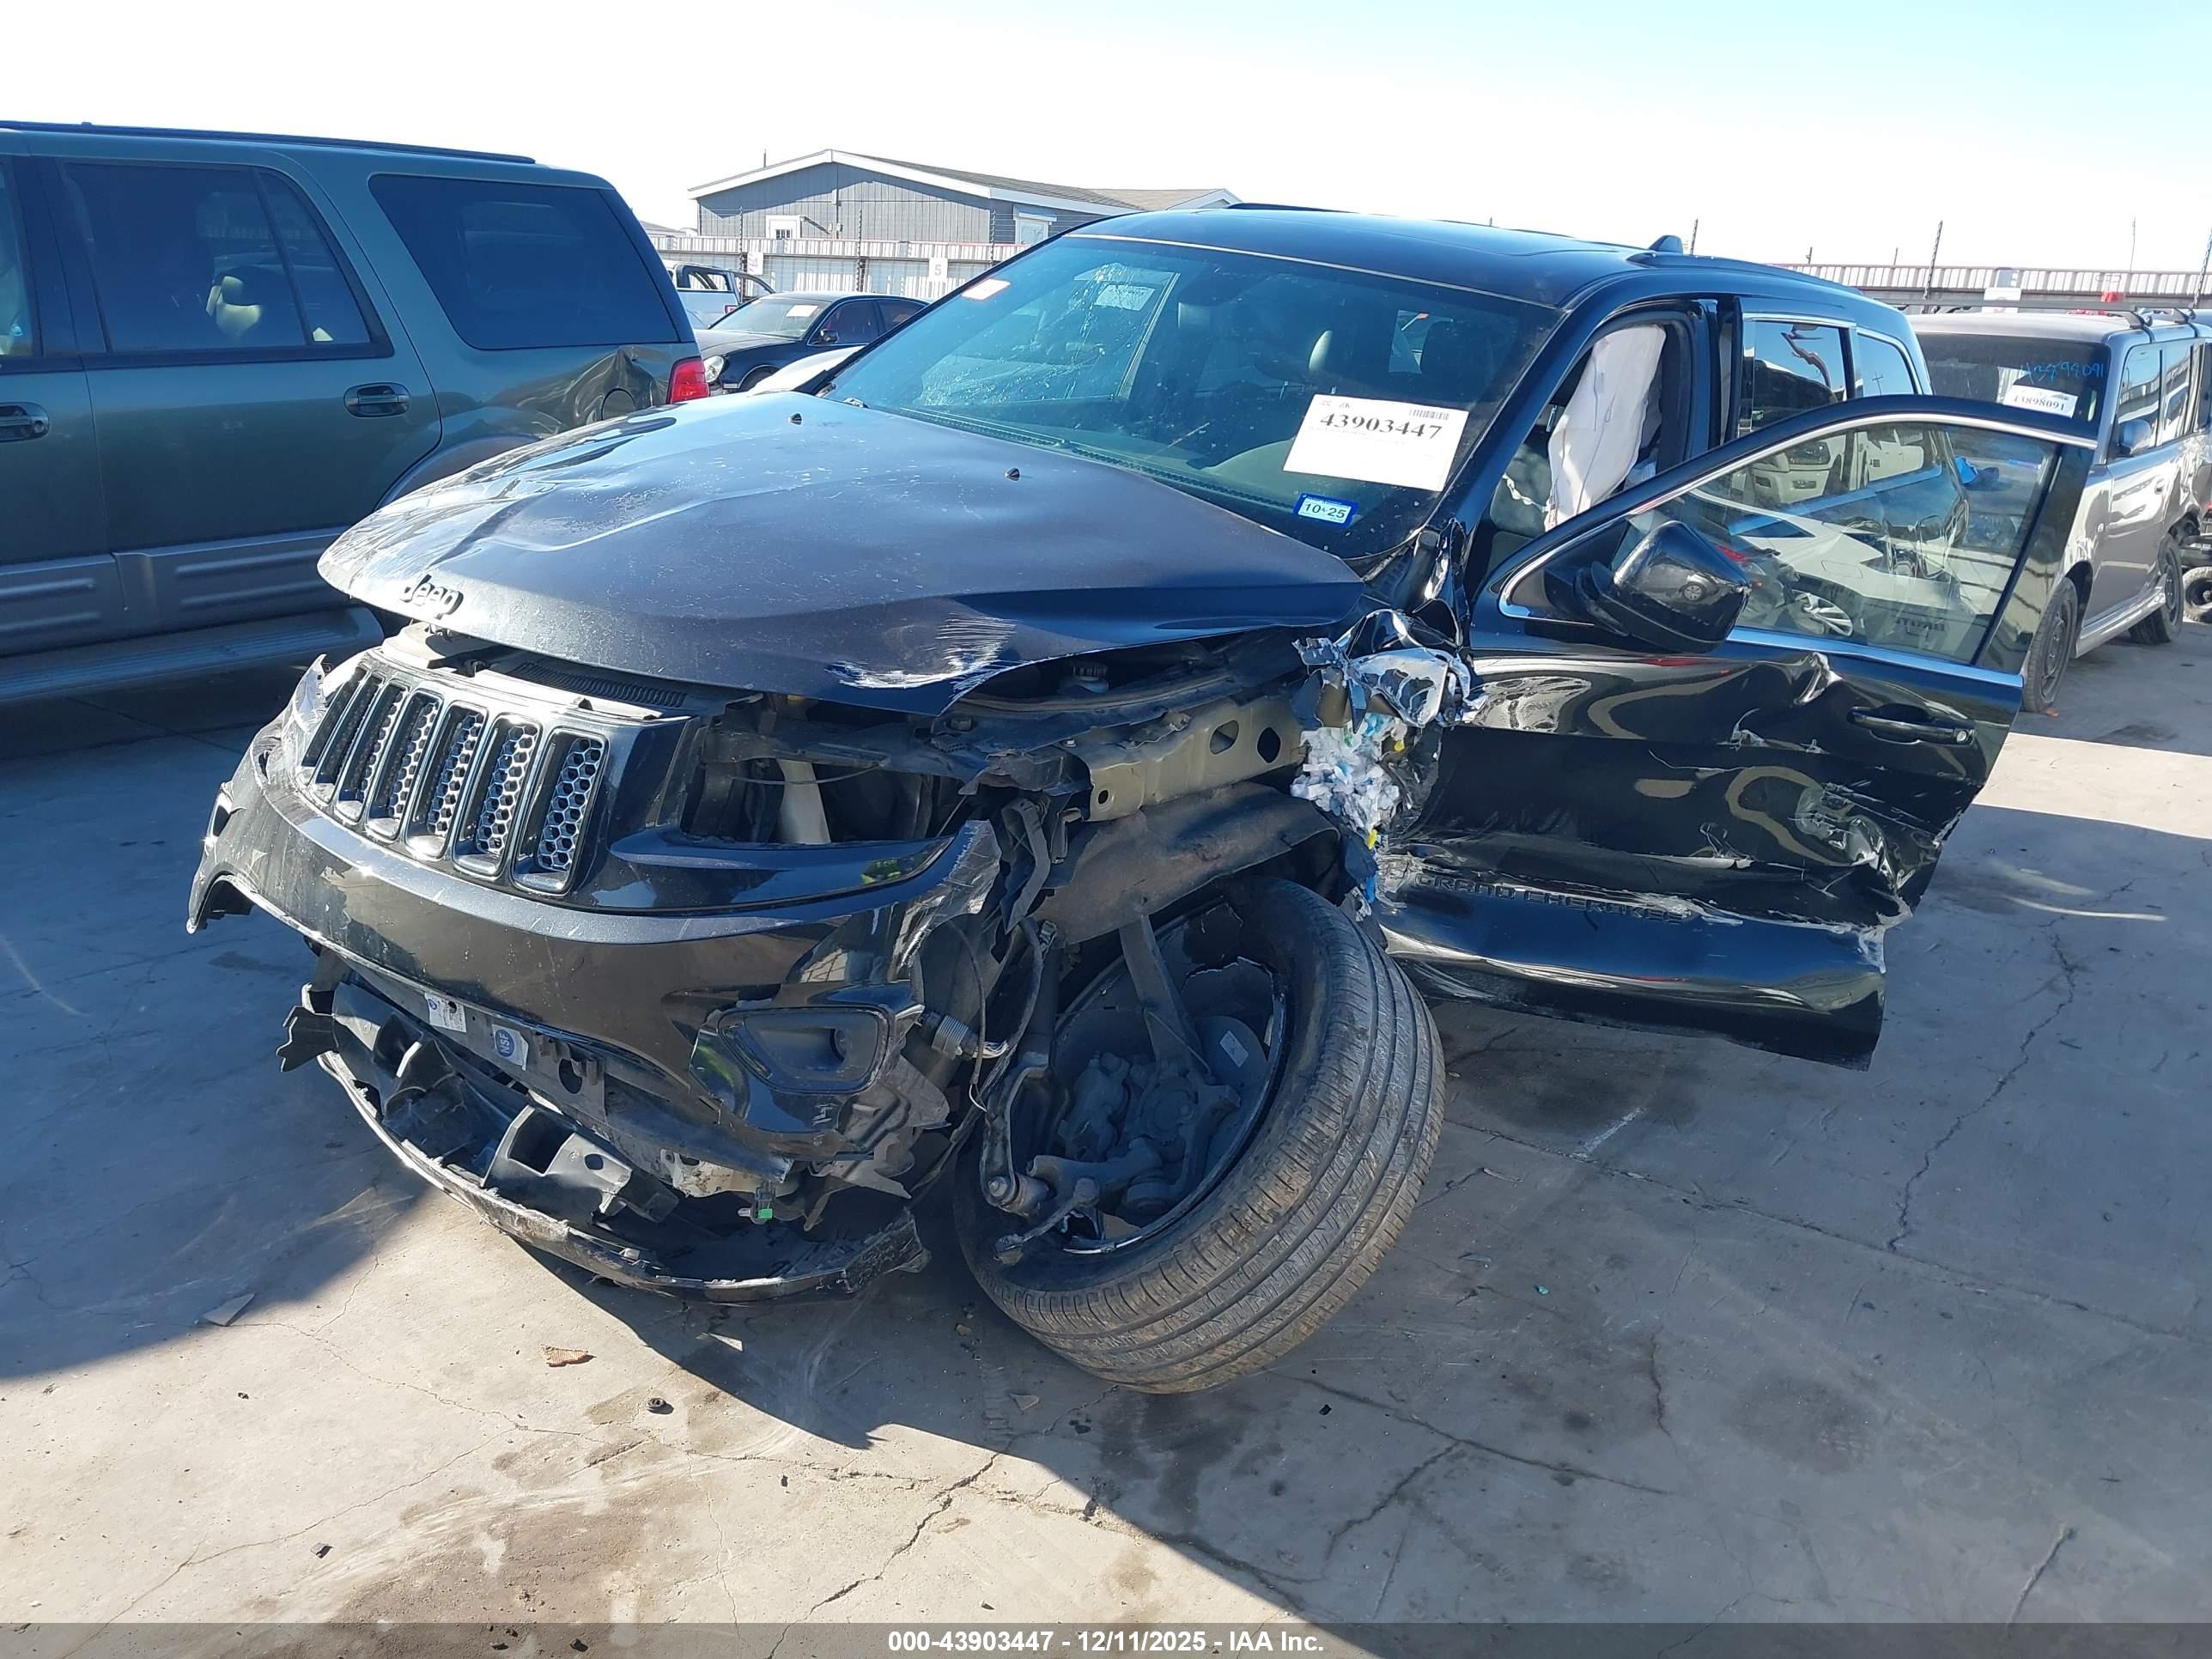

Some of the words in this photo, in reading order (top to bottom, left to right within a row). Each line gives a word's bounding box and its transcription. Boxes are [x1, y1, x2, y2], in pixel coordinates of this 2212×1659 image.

[934, 264, 942, 276] 5
[1320, 413, 1443, 439] 43903447
[398, 574, 464, 620] Jeep
[1416, 873, 1516, 899] GRAND
[499, 1031, 511, 1054] NSF
